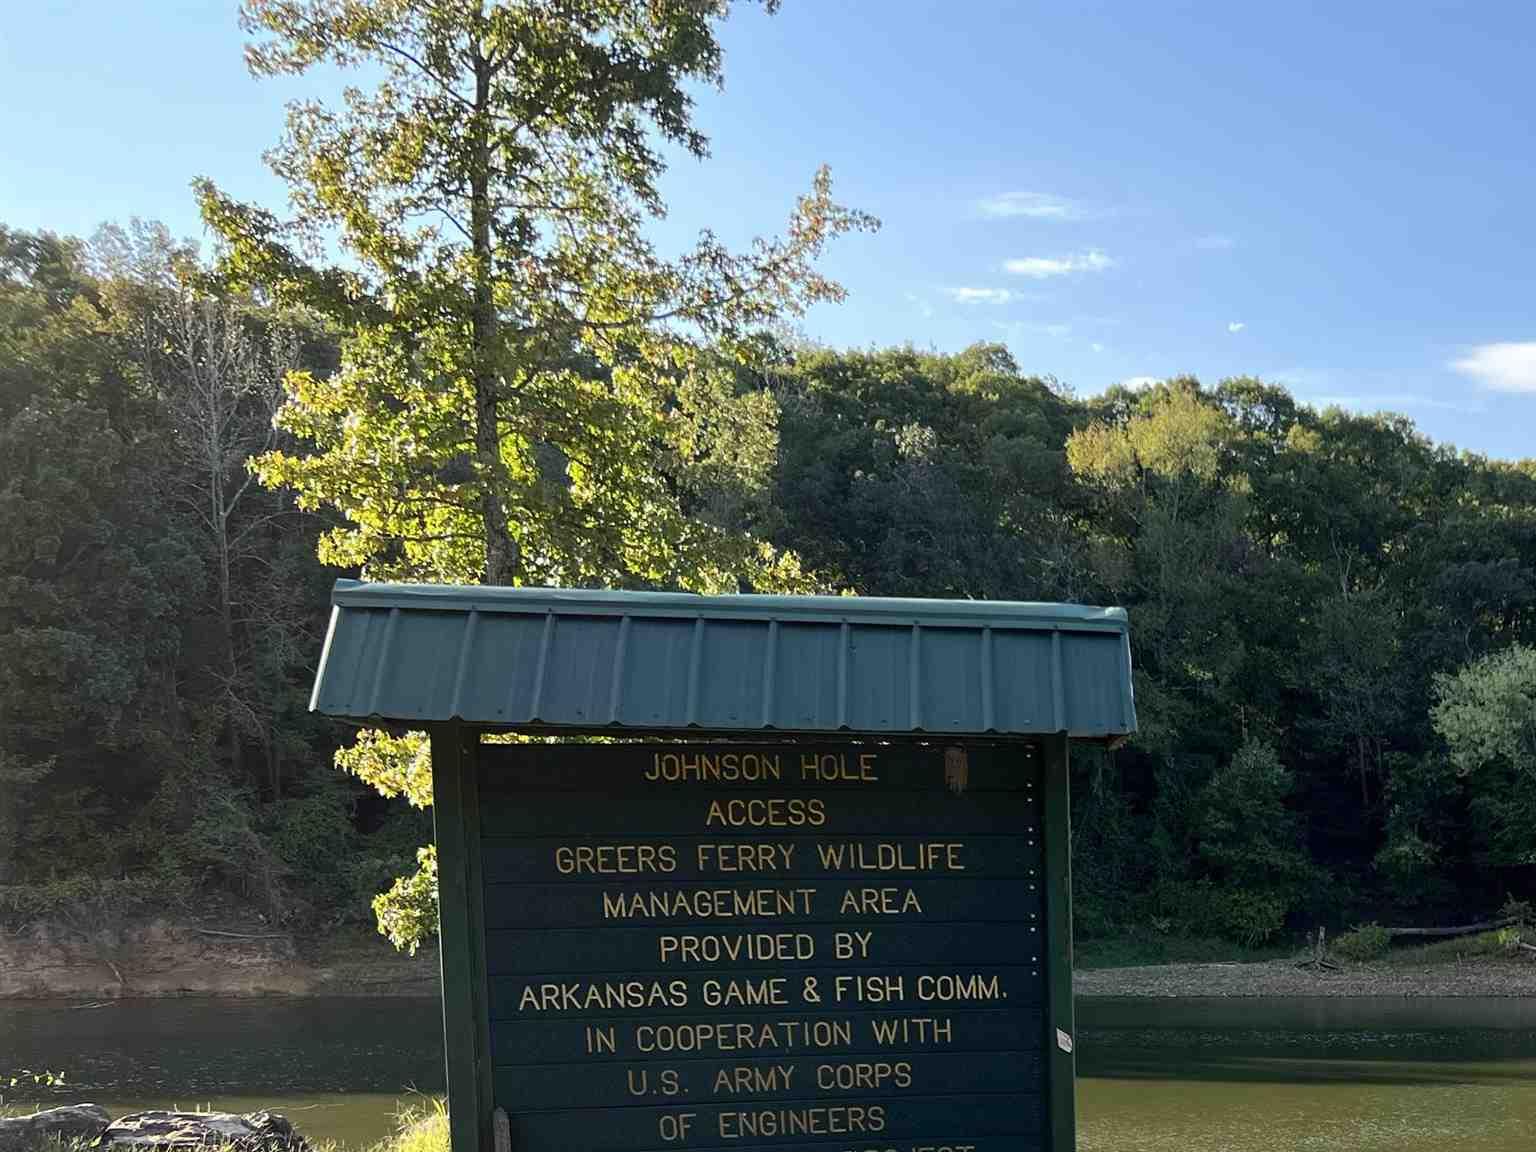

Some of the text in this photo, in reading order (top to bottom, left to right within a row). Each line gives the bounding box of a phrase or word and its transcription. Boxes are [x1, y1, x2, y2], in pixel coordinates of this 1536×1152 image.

[644, 753, 878, 781] JOHNSON HOLE
[706, 799, 826, 826] ACCESS
[555, 843, 965, 874] GREERS FERRY WILDLIFE
[602, 888, 922, 919] MANAGEMENT AREA
[660, 931, 873, 962] PROVIDED BY
[519, 975, 1008, 1011] ARKANSAS GAME & FISH COMM.
[586, 1018, 952, 1054] IN COOPERATION WITH
[627, 1062, 913, 1096] U.S. ARMY CORPS
[659, 1106, 885, 1142] OF ENGINEERS
